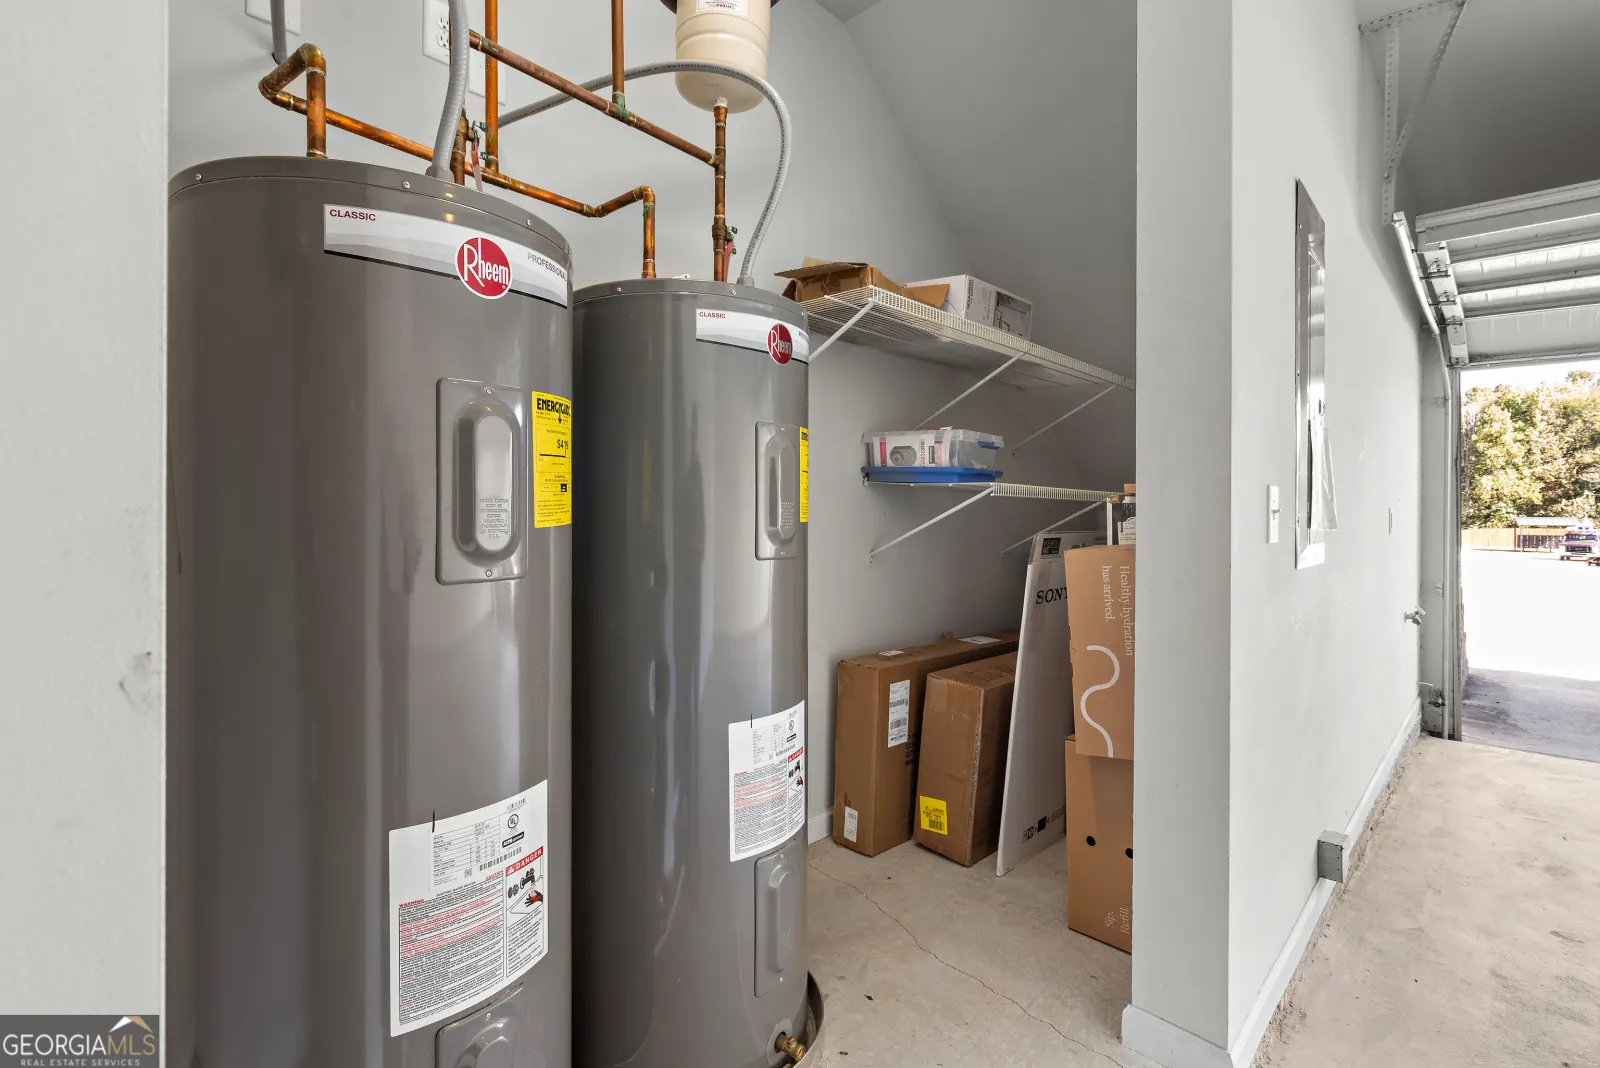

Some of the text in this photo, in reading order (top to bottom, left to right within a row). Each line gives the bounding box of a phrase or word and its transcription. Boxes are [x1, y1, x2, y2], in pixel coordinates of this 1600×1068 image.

[329, 208, 377, 222] CLASSIC
[463, 237, 509, 287] Rheem
[527, 252, 567, 282] PROFESSIONAL
[699, 311, 725, 319] CLASSIC
[770, 325, 792, 358] Rheem
[1102, 565, 1116, 622] has arrived.
[1120, 565, 1134, 656] Healthy hydration
[516, 848, 542, 870] DANGER
